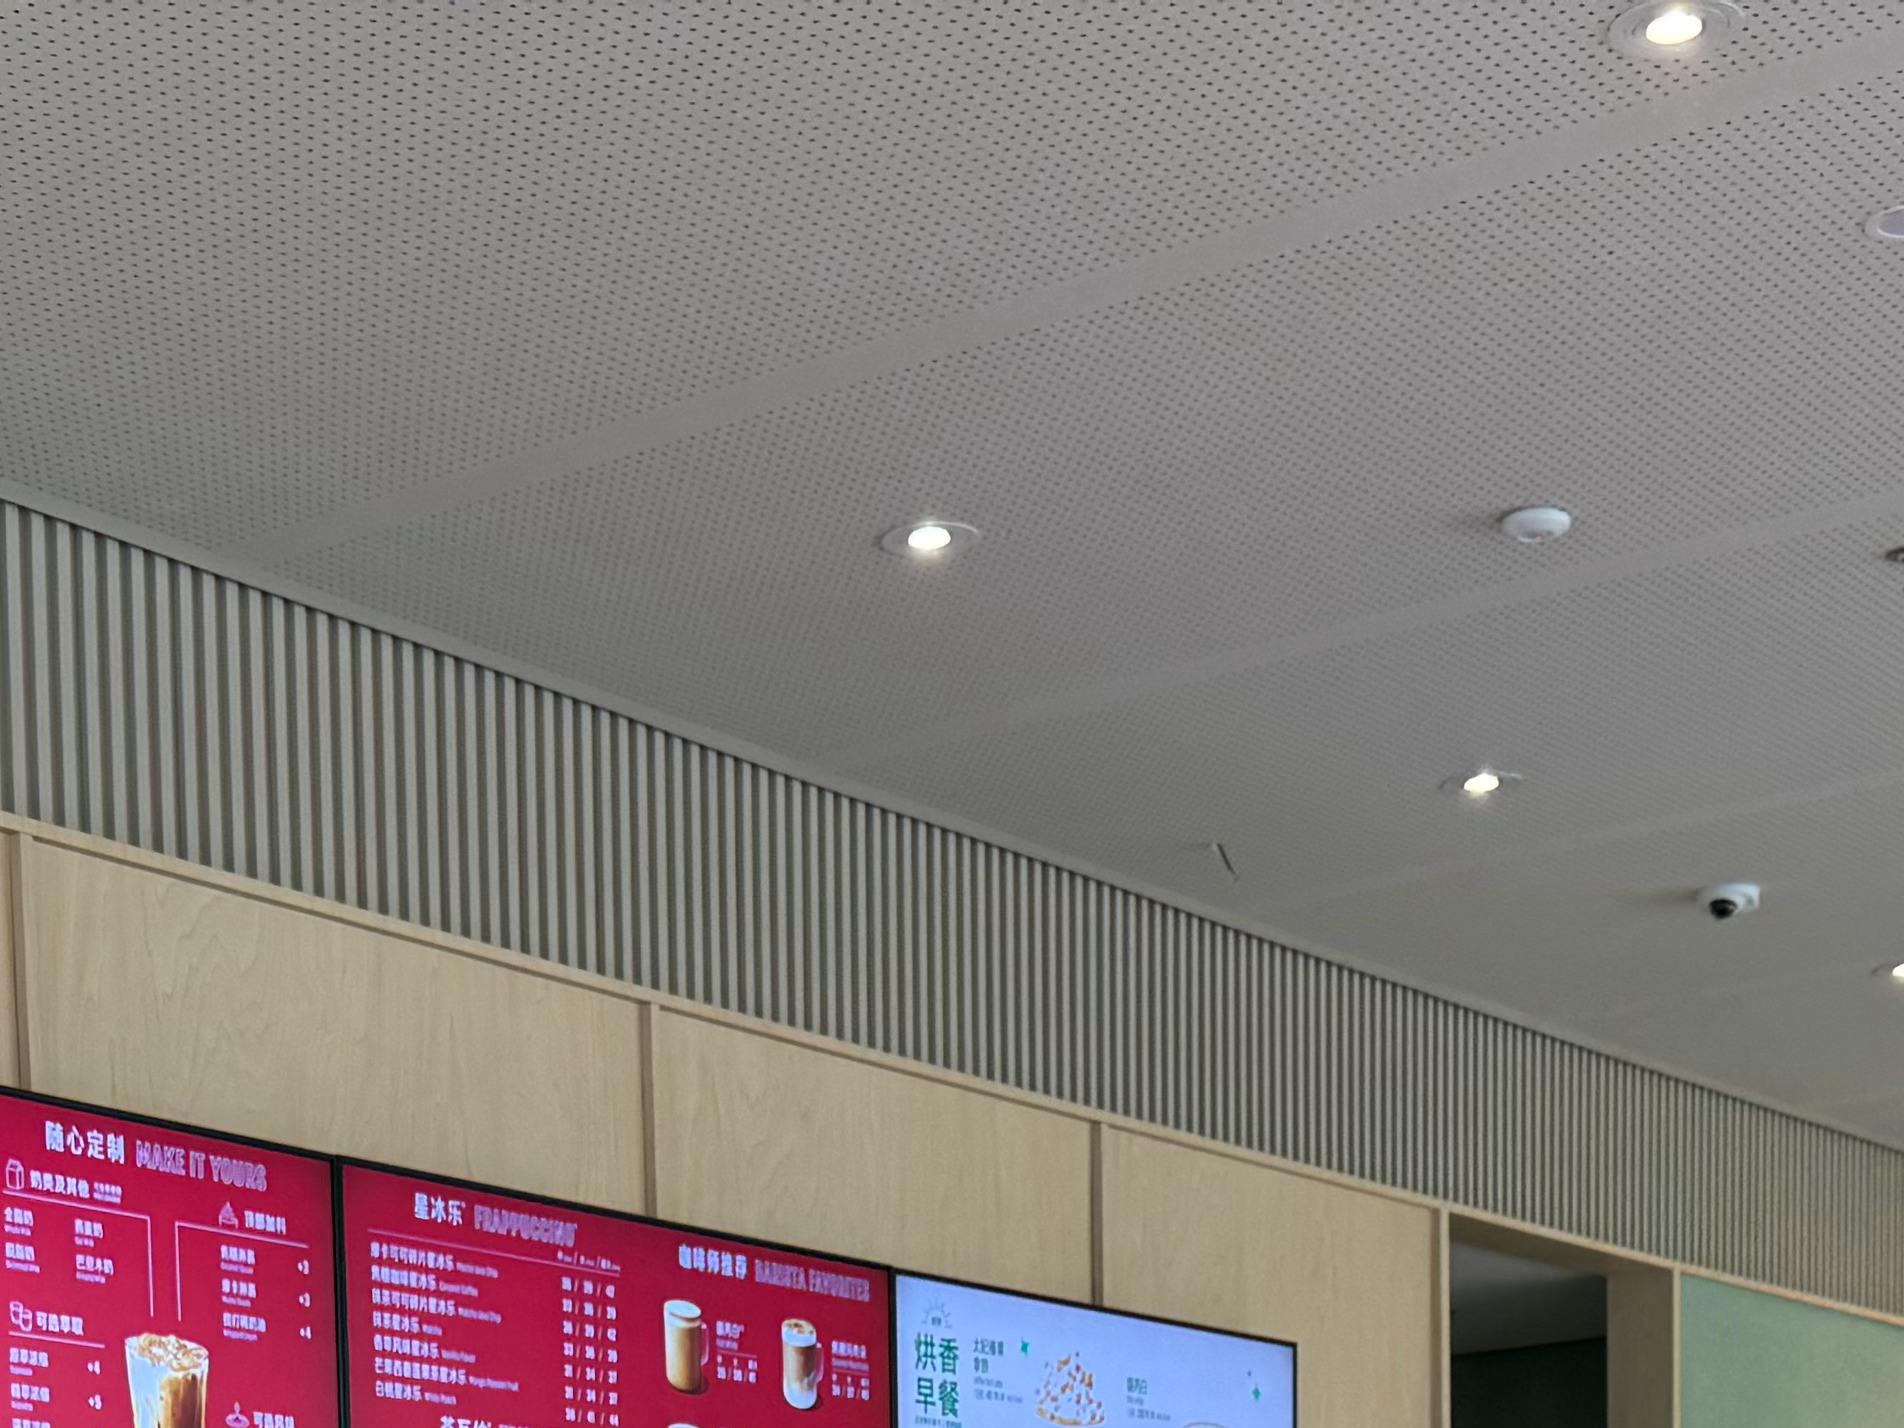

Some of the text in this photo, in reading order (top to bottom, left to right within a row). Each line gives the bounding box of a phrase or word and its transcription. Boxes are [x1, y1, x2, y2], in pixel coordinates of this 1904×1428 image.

[45, 1120, 268, 1191] 随心定制 MAKE IT YOURS
[414, 1192, 466, 1226] 星冰乐
[915, 1332, 959, 1375] 烘香
[915, 1377, 959, 1418] 早餐
